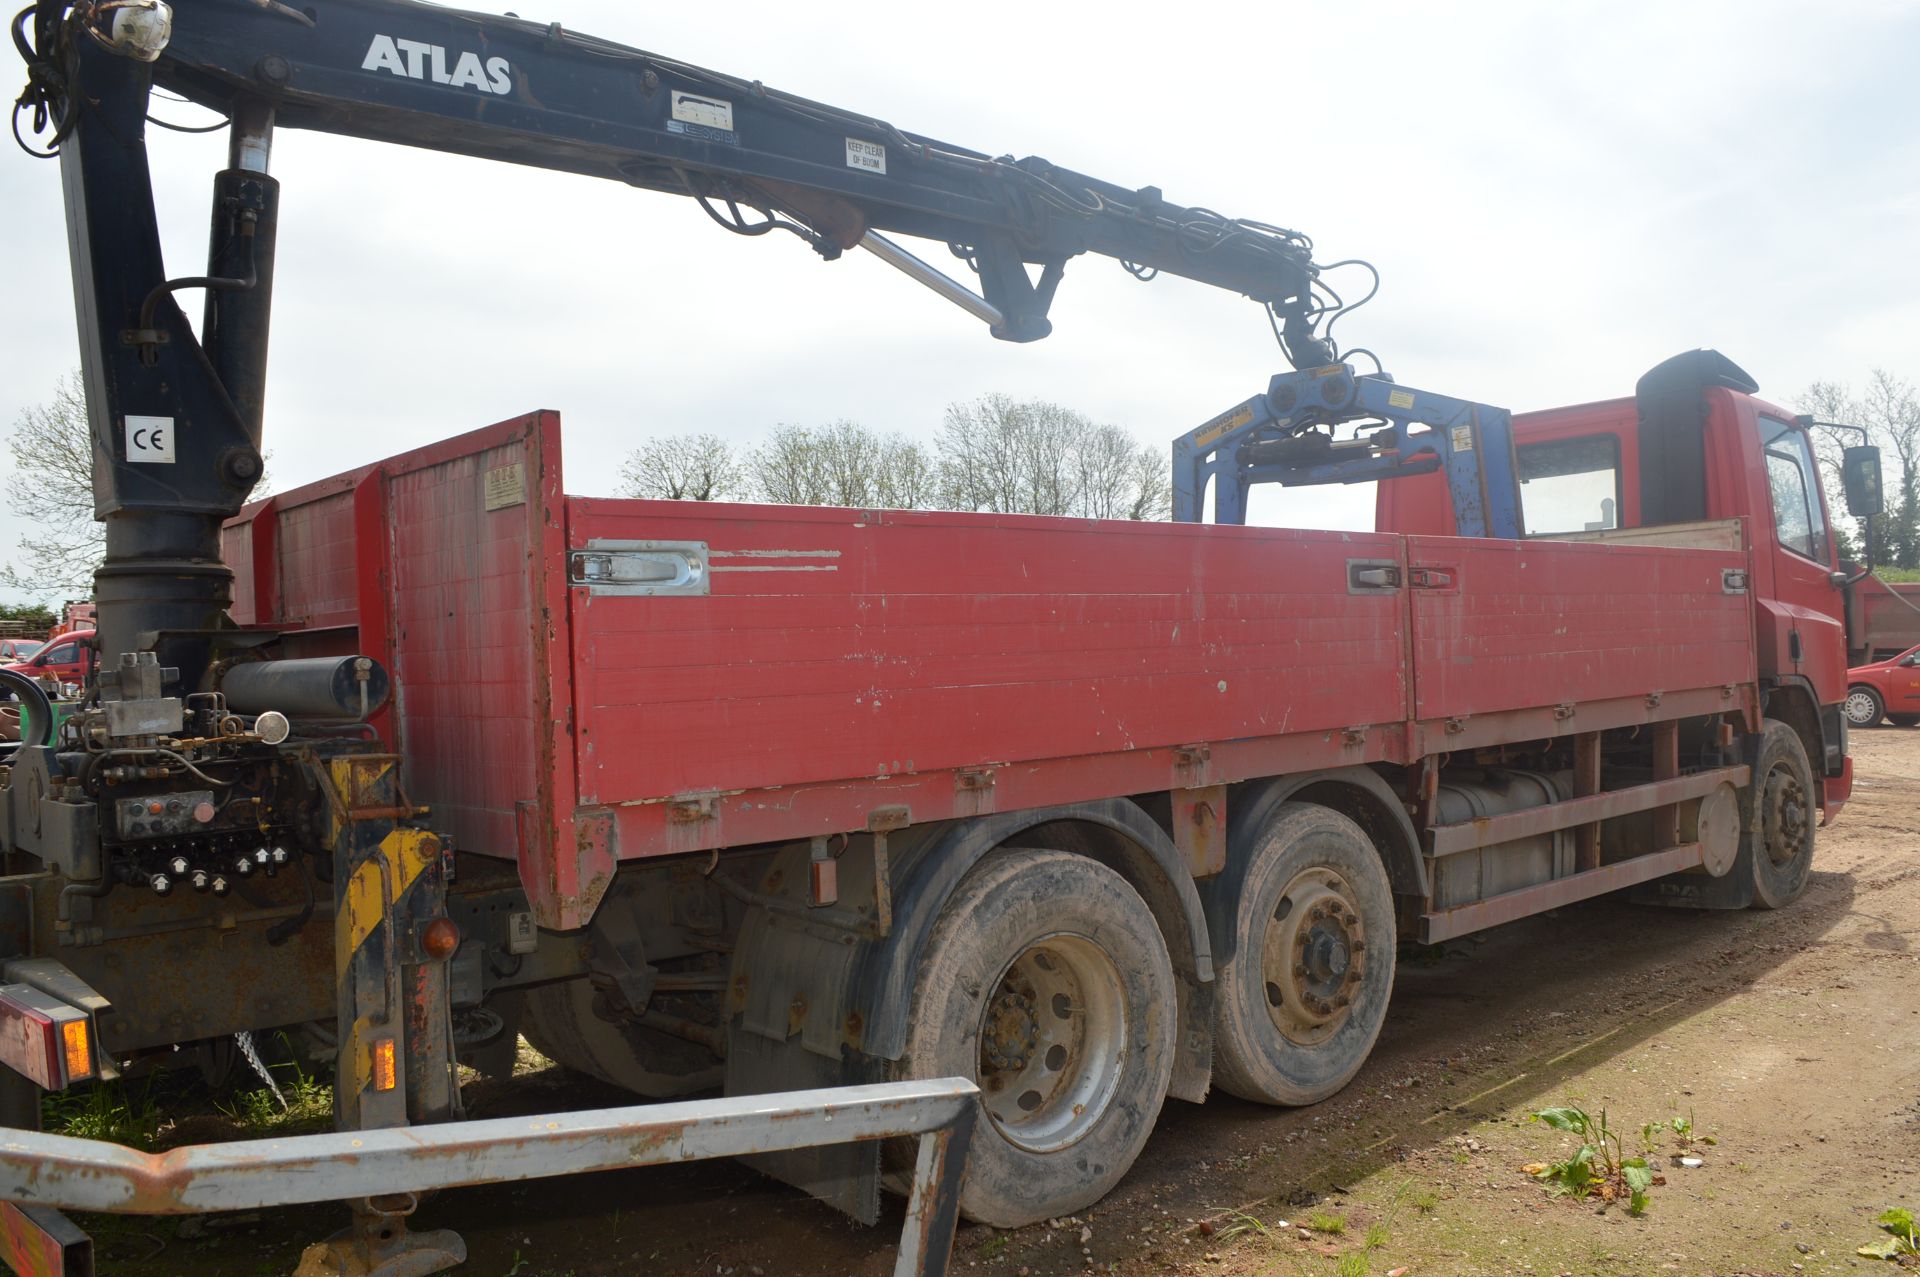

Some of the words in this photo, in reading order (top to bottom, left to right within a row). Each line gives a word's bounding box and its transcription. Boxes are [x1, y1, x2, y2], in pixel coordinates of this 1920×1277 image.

[361, 34, 512, 95] ATLAS
[848, 142, 863, 153] KEEP
[865, 145, 884, 159] CLEAR
[853, 154, 861, 164] OF
[862, 156, 880, 169] BOOM
[133, 428, 164, 451] CE
